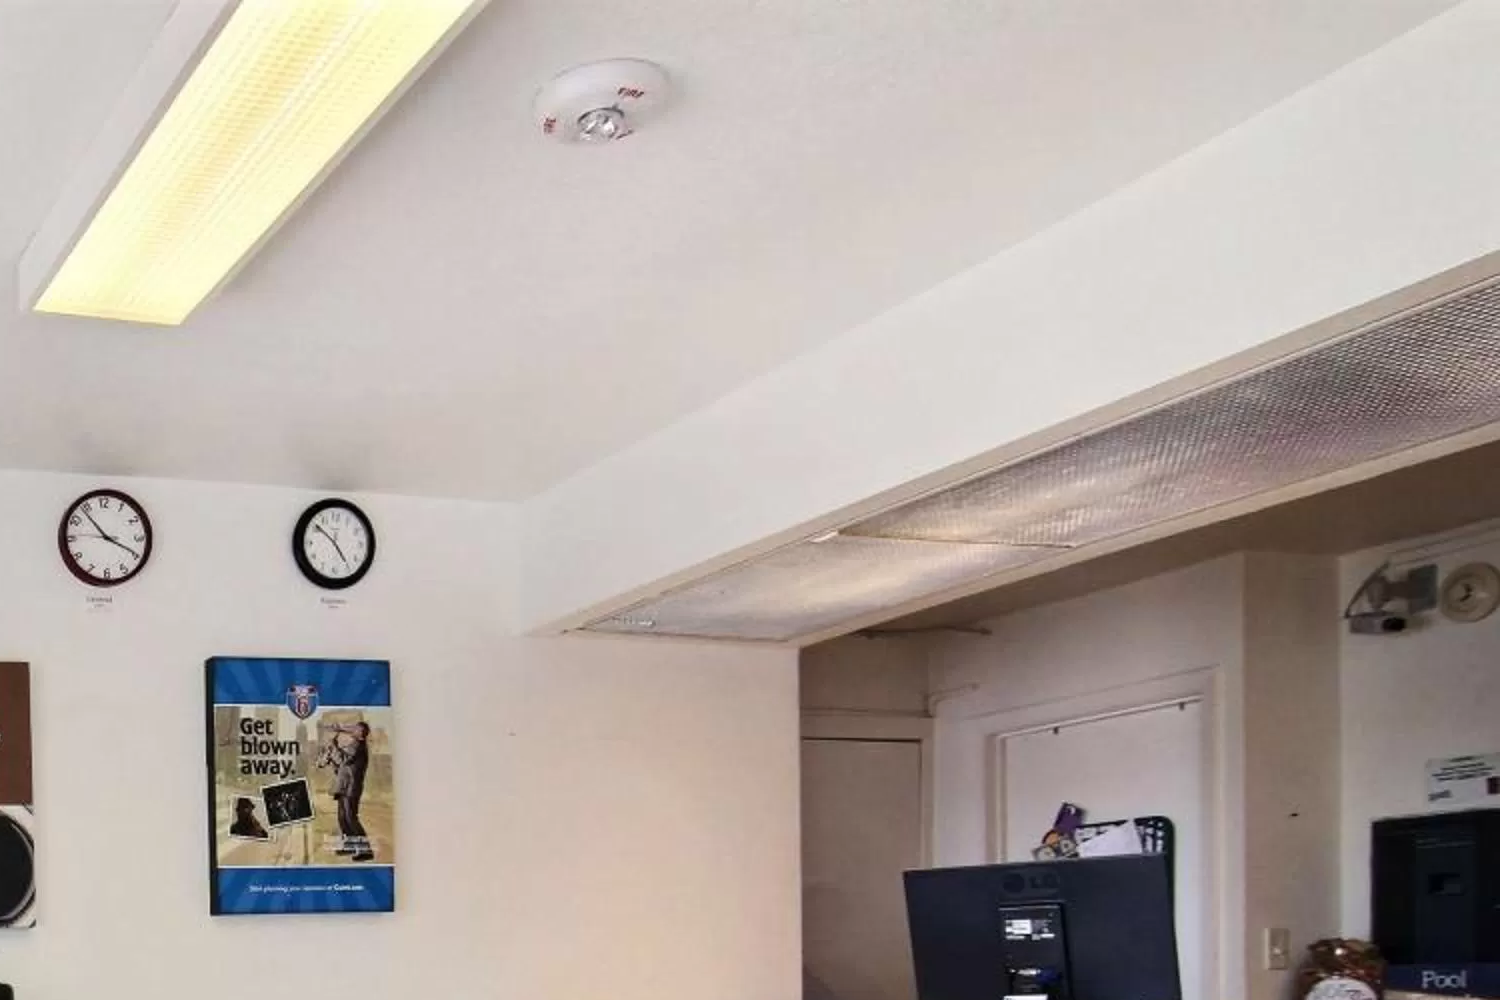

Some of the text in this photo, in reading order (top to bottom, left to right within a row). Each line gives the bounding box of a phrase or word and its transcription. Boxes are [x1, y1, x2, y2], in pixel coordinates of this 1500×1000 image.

[99, 498, 109, 509] 12
[240, 718, 273, 735] Get
[241, 736, 300, 756] blown
[241, 759, 297, 778] away.
[1421, 969, 1468, 989] Pool
